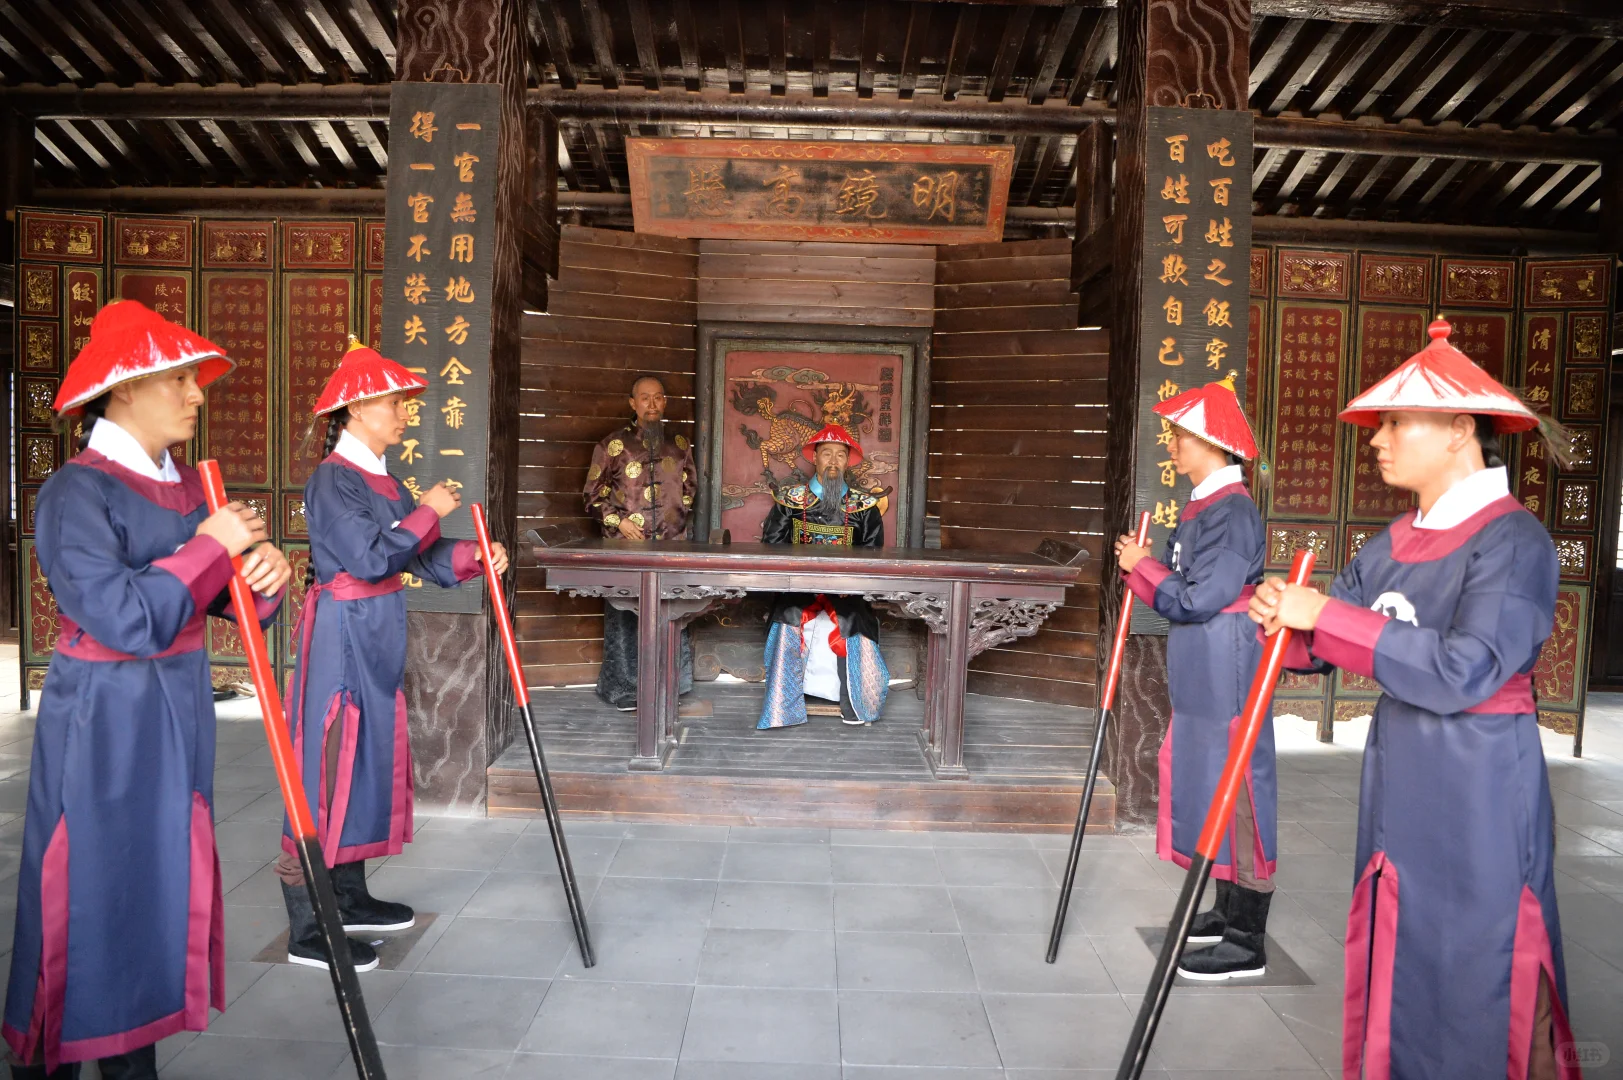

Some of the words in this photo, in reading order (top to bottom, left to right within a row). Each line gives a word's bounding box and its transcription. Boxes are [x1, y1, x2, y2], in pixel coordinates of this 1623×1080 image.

[683, 164, 960, 222] 明鏡高懸
[1202, 137, 1235, 370] 吃百姓之飯穿
[1522, 327, 1552, 513] 清似鈞聞夜雨
